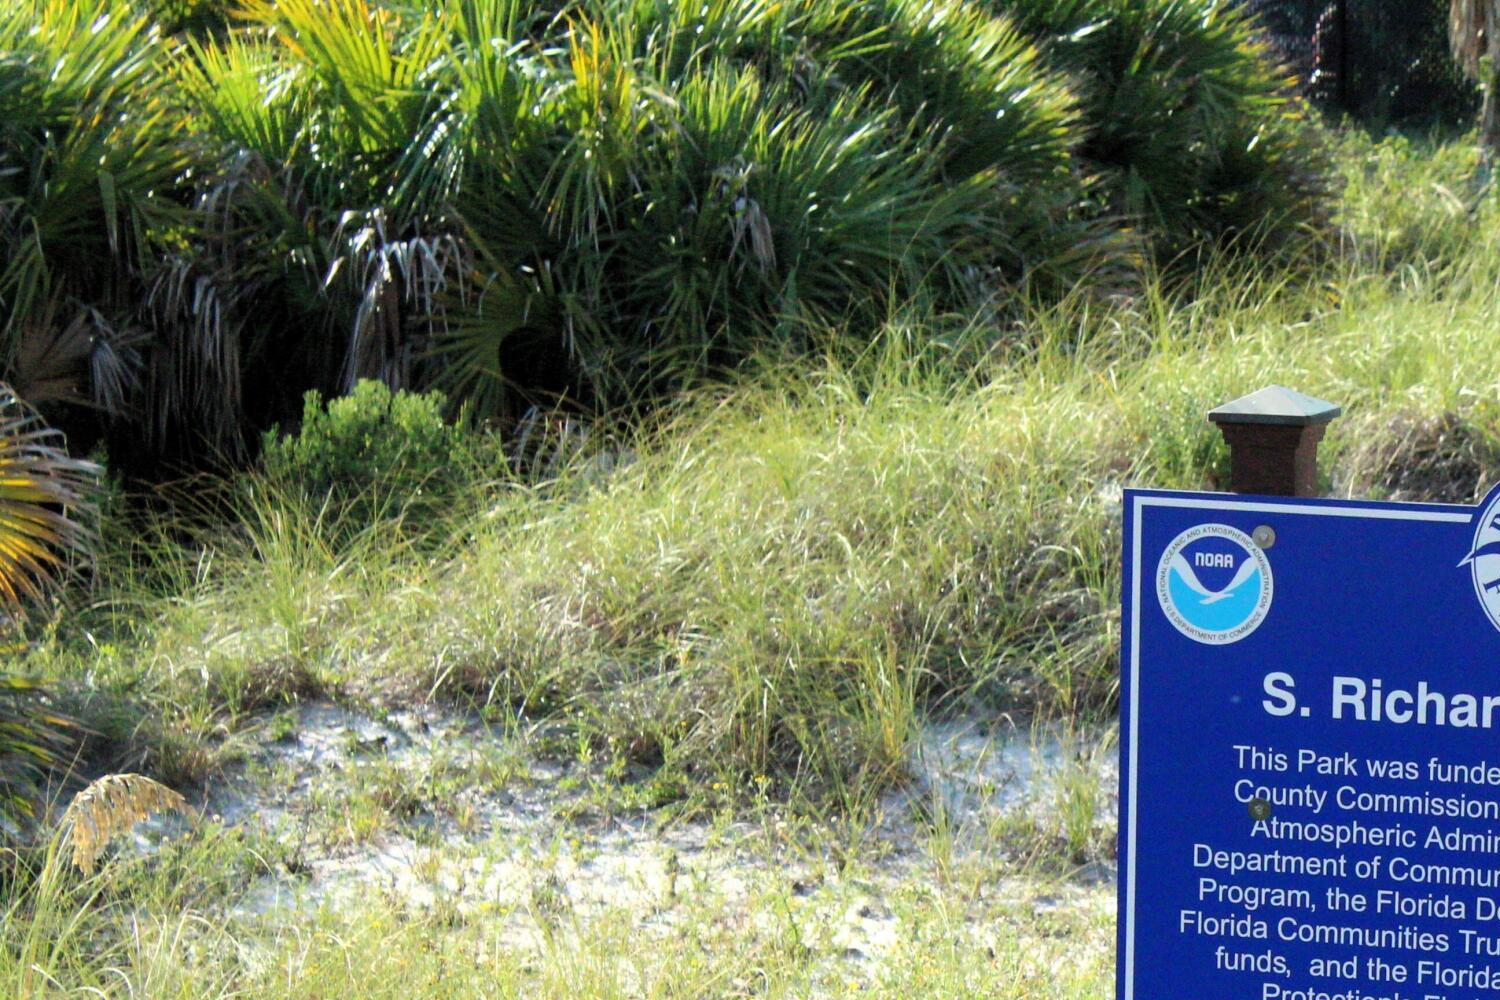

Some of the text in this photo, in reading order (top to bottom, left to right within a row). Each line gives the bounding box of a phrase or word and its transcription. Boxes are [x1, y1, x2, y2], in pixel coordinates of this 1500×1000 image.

[1195, 552, 1234, 568] NOAA
[1262, 671, 1311, 718] S.
[1232, 744, 1288, 772] This
[1297, 748, 1358, 777] Park
[1365, 759, 1420, 780] was
[1234, 778, 1328, 814] County
[1250, 815, 1417, 849] Atmospheric
[1192, 843, 1347, 878] Department
[1354, 855, 1382, 880] of
[1198, 877, 1316, 913] Program,
[1325, 886, 1367, 913] the
[1376, 889, 1466, 920] Florida
[1179, 910, 1268, 939] Florida
[1277, 916, 1450, 953] Communities
[1214, 945, 1291, 978] funds,
[1309, 955, 1358, 980] and
[1366, 957, 1408, 983] the
